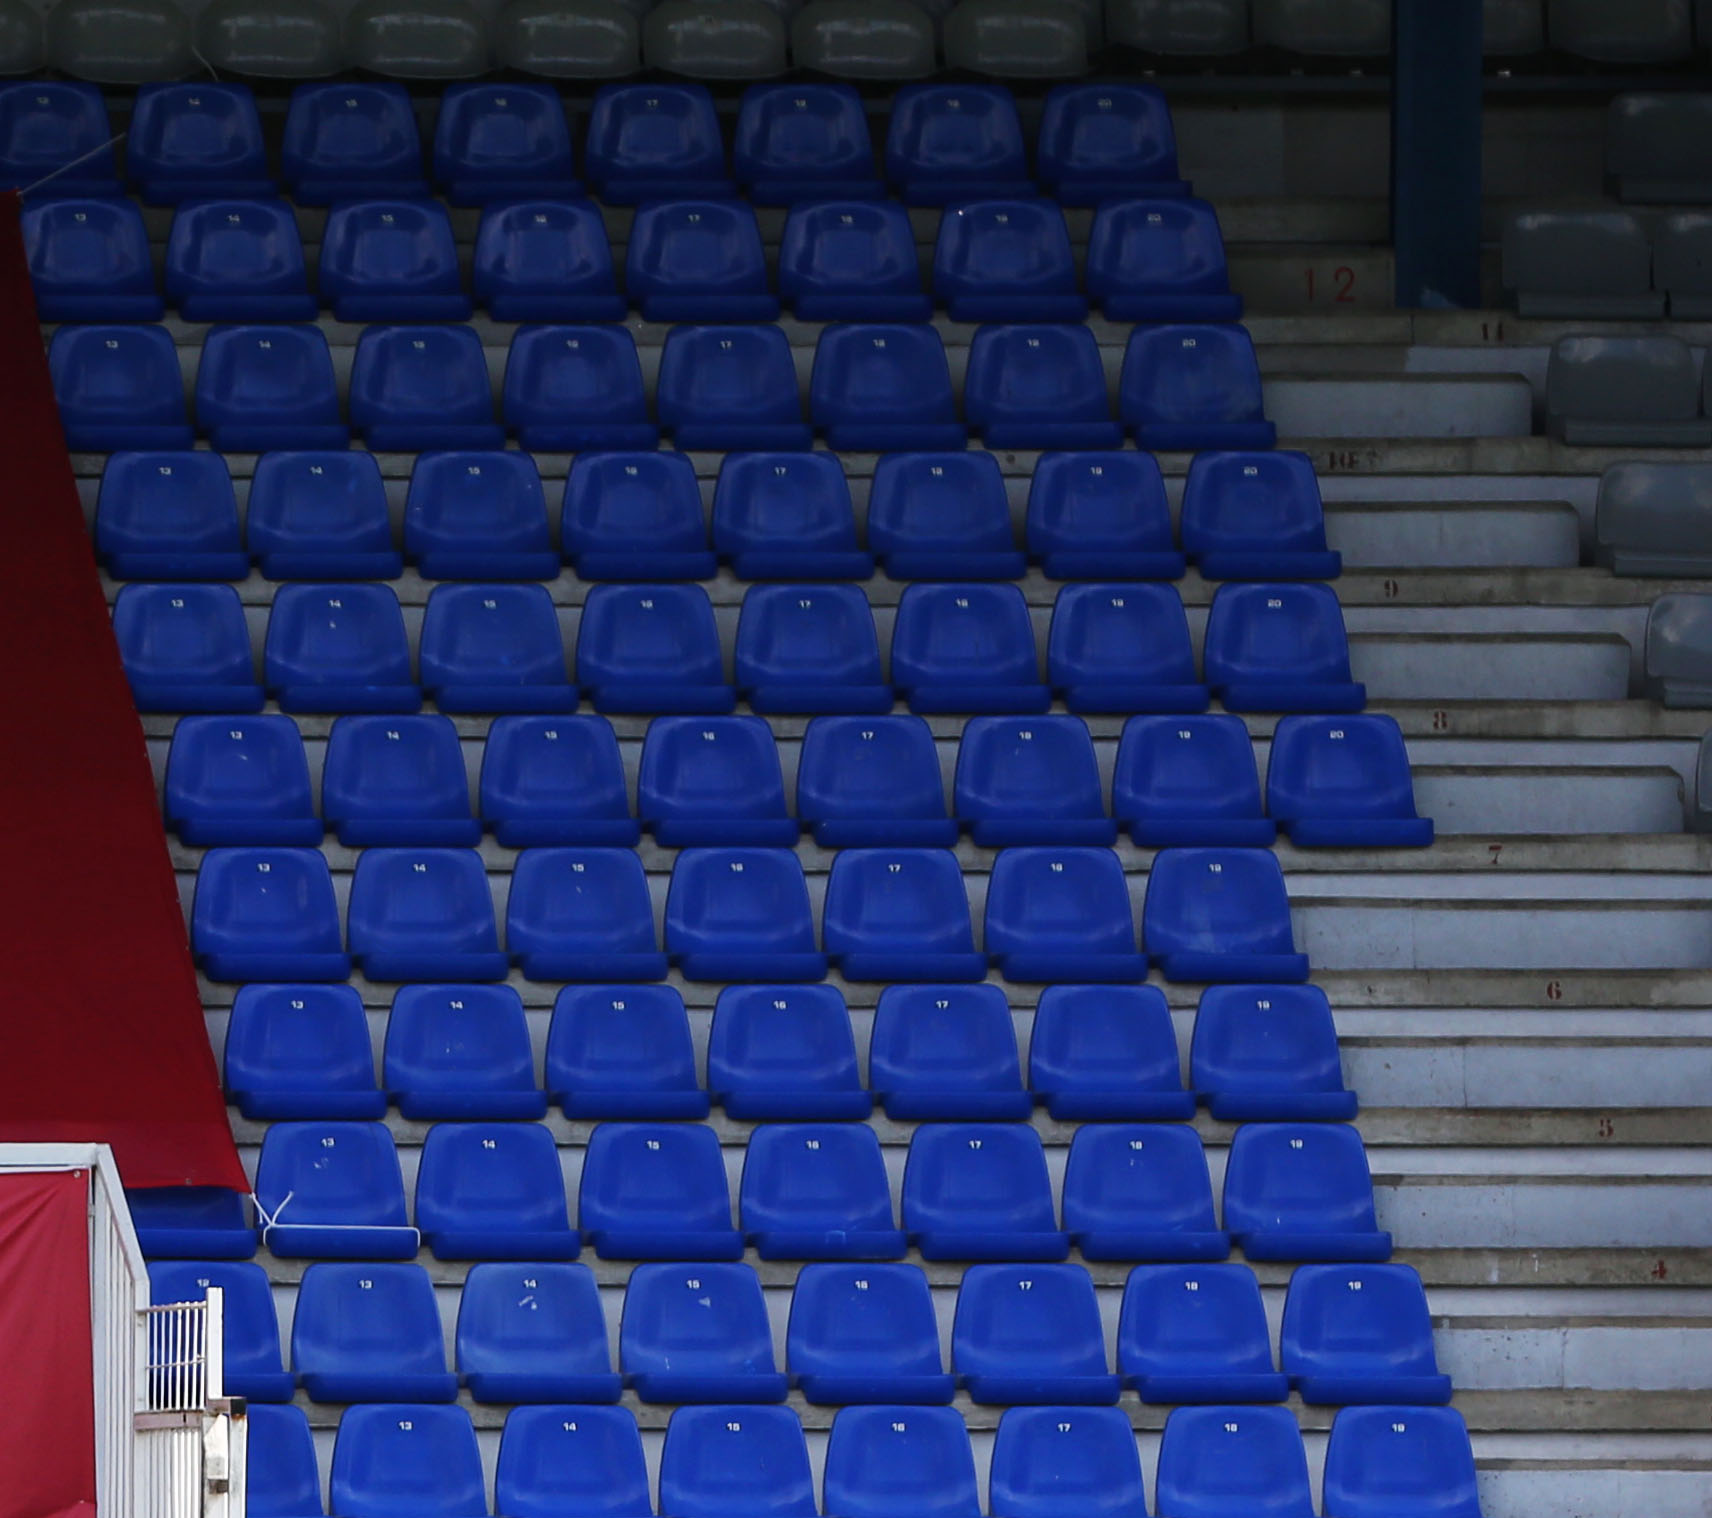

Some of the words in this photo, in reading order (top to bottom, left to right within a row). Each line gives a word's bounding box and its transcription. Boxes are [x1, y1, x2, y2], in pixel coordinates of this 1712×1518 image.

[1304, 266, 1357, 303] 12
[1383, 578, 1399, 599] 9
[1487, 844, 1504, 865] 7
[1546, 980, 1563, 1001] 6
[935, 1000, 949, 1009] 17
[1598, 1118, 1615, 1138] 5
[968, 1139, 982, 1149] 17
[1650, 1259, 1668, 1280] 4
[1019, 1280, 1033, 1291] 17
[398, 1420, 413, 1431] 13
[1057, 1422, 1071, 1433] 17
